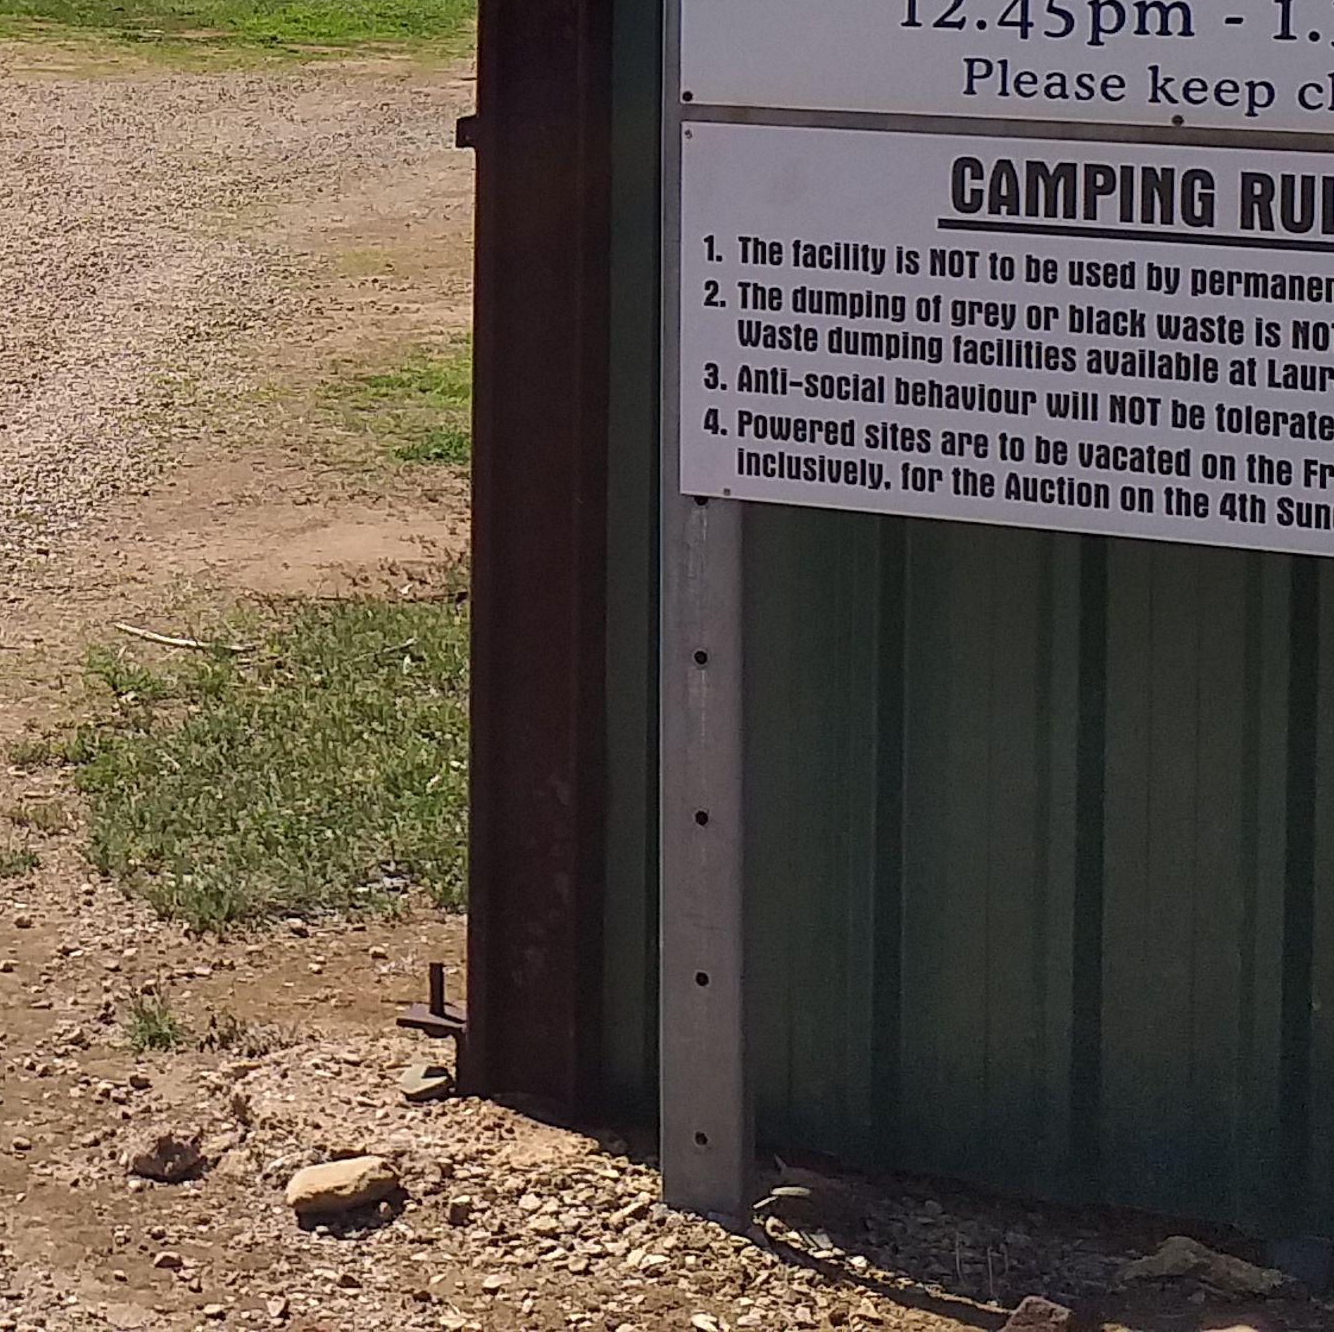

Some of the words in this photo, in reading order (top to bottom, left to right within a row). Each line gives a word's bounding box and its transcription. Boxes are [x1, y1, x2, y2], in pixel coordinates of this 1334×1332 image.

[963, 58, 1125, 101] Please
[1148, 65, 1275, 117] keep
[951, 156, 1216, 228] CAMPING
[704, 235, 722, 262] 1.
[738, 237, 782, 265] The
[793, 240, 885, 275] facility
[897, 246, 919, 275] is
[930, 249, 979, 278] NOT
[989, 253, 1014, 281] to
[1026, 255, 1057, 284] be
[1069, 261, 1135, 289] used
[1147, 263, 1180, 294] by
[704, 281, 726, 307] 2.
[738, 282, 782, 311] The
[793, 286, 905, 322] dumping
[917, 295, 941, 322] of
[951, 300, 1016, 330] grey
[1027, 306, 1059, 331] or
[1069, 305, 1145, 338] black
[1157, 314, 1243, 345] waste
[1256, 318, 1280, 347] is
[738, 320, 817, 351] Waste
[828, 327, 942, 363] dumping
[953, 335, 1076, 372] facilities
[1087, 349, 1218, 383] available
[1230, 358, 1256, 386] at
[704, 363, 727, 390] 3.
[738, 365, 884, 403] Anti-social
[896, 378, 1036, 415] behaviour
[1047, 391, 1098, 421] will
[1110, 395, 1161, 426] NOT
[1172, 400, 1204, 429] be
[704, 408, 727, 435] 4.
[738, 410, 854, 446] Powered
[865, 422, 930, 453] sites
[942, 431, 988, 458] are
[999, 433, 1024, 461] to
[1036, 436, 1067, 465] be
[1079, 443, 1190, 477] vacated
[1202, 454, 1235, 481] on
[1247, 454, 1292, 485] the
[902, 463, 942, 492] for
[952, 468, 994, 498] the
[1005, 473, 1109, 509] Auction
[1121, 486, 1153, 513] on
[1164, 487, 1208, 518] the
[1220, 493, 1265, 523] 4th
